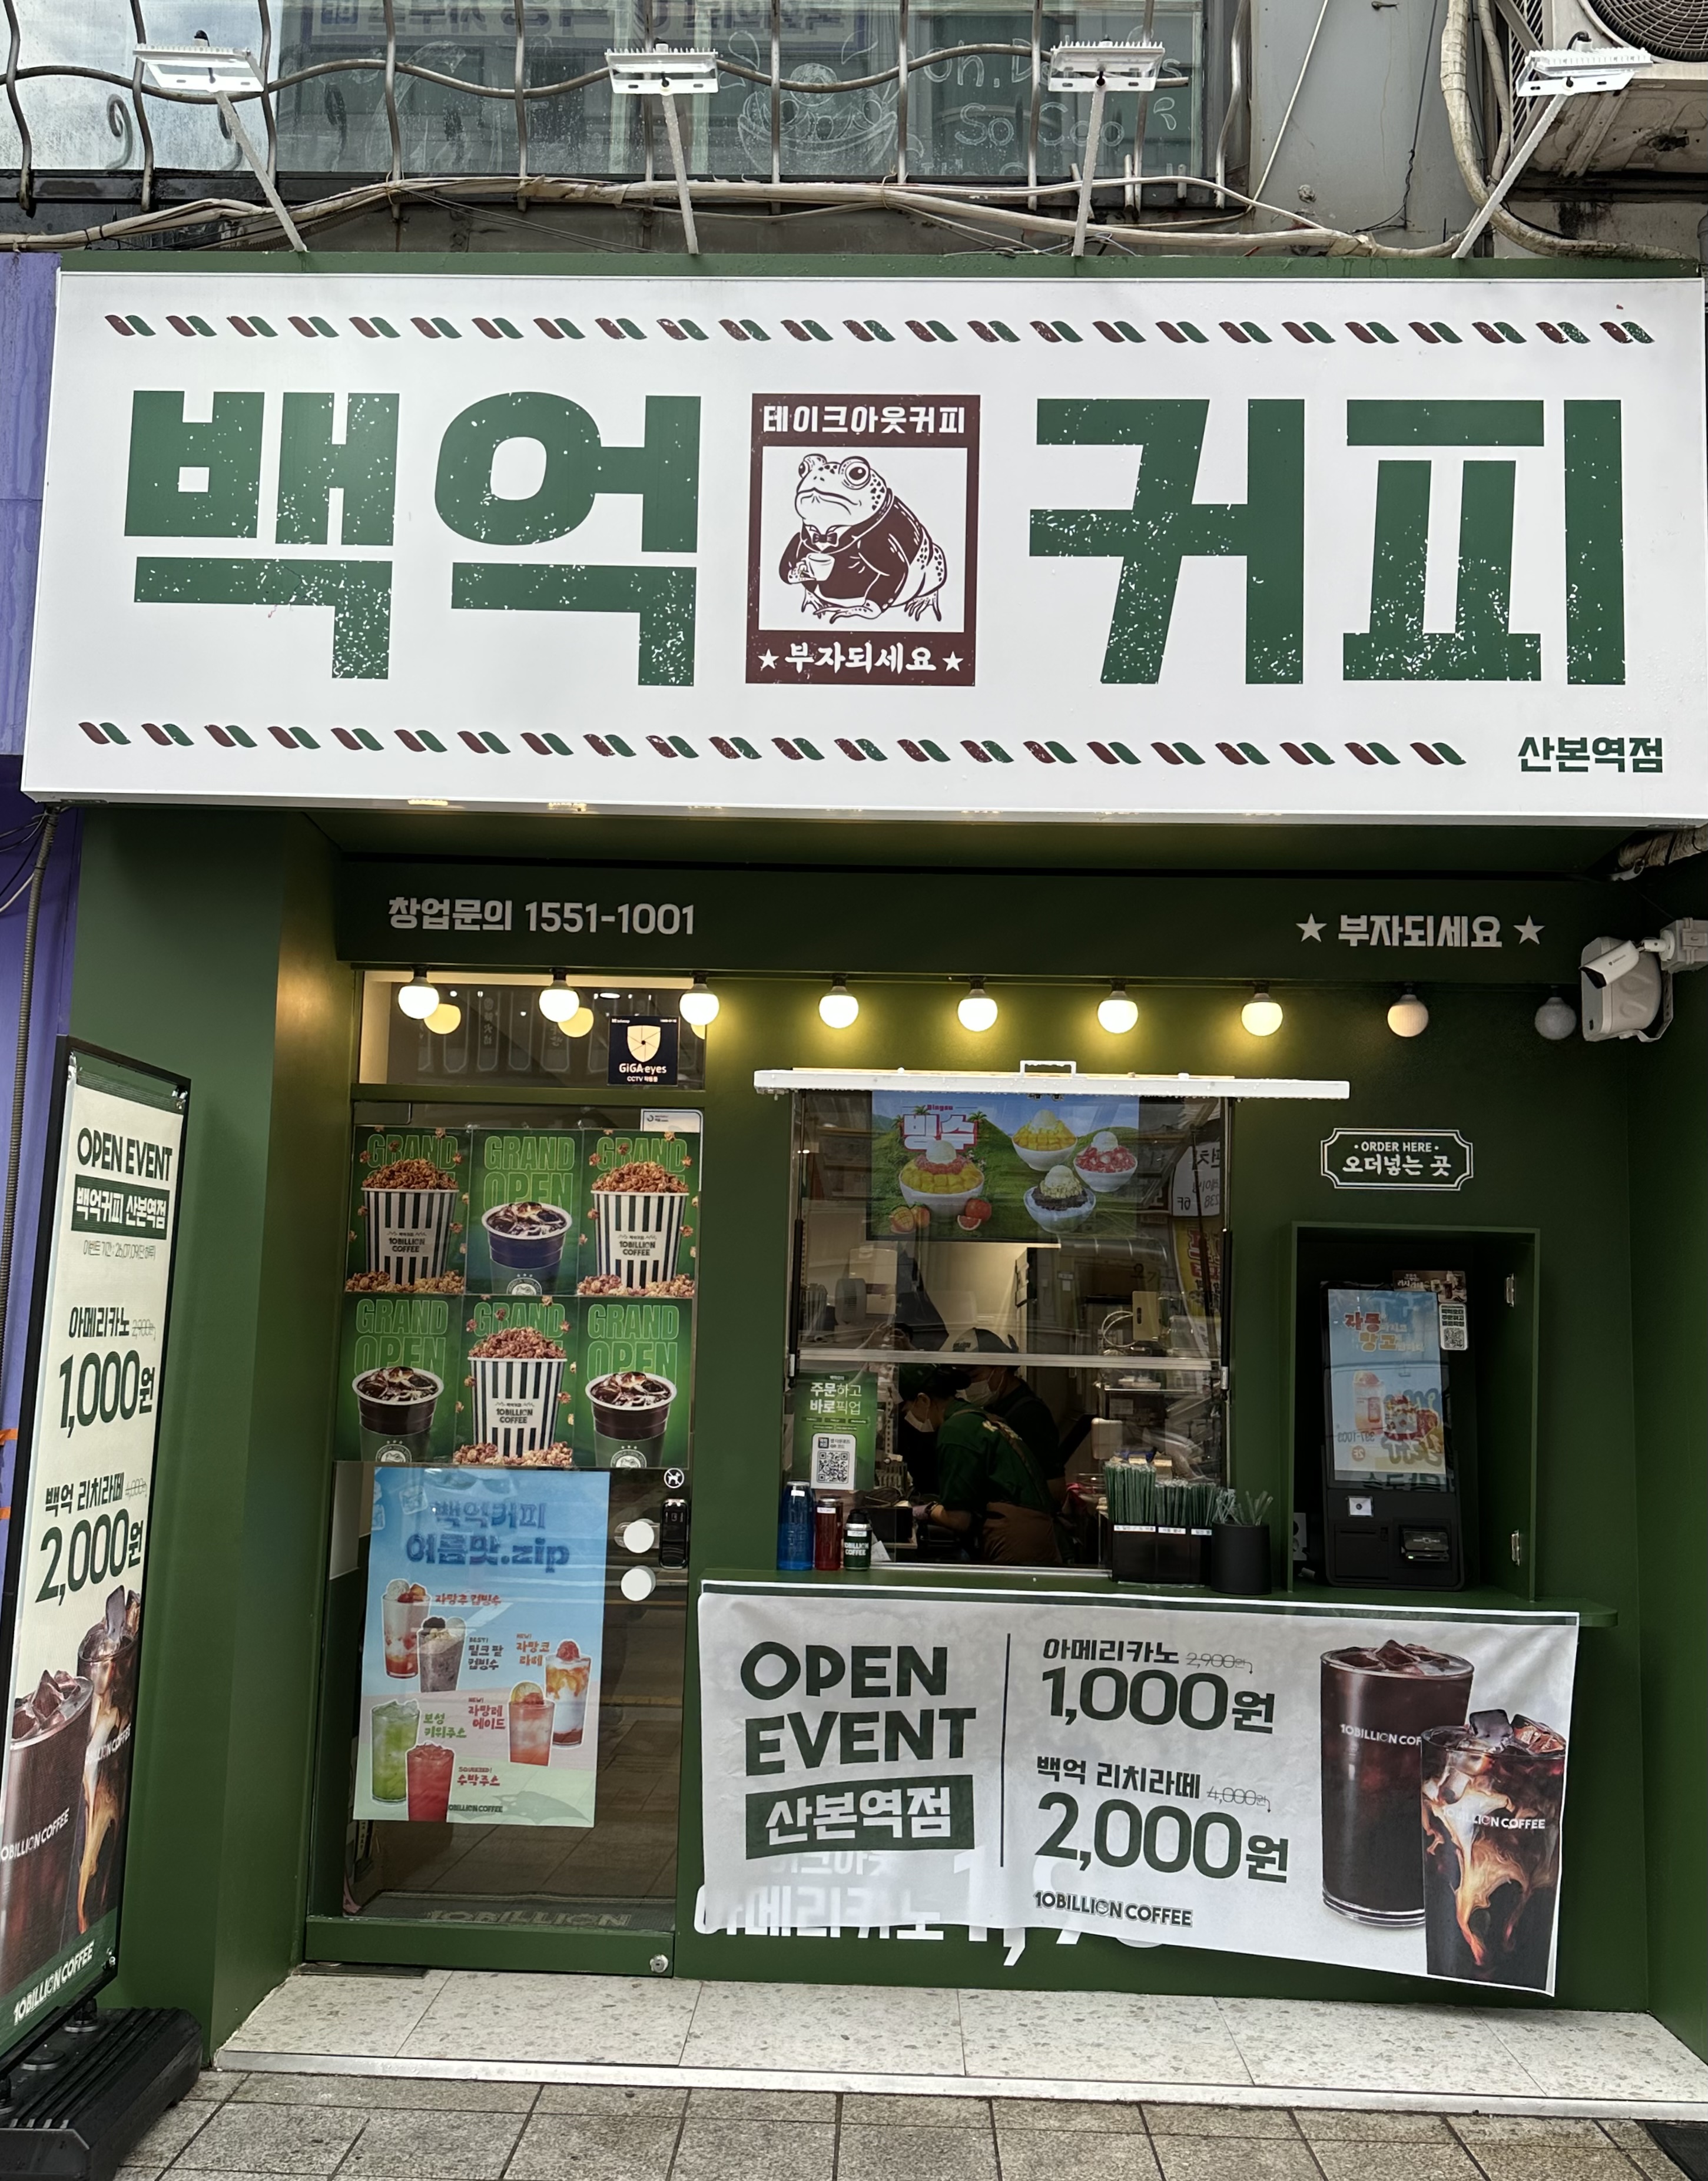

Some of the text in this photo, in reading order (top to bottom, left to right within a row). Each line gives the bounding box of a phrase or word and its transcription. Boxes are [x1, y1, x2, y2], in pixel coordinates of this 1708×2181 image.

[954, 102, 1014, 146] So
[763, 405, 965, 433] 테이크아웃커피
[124, 390, 1626, 687] 백억 커피
[785, 641, 937, 674] 부자되세요
[1517, 737, 1663, 773] 산본역점
[389, 897, 694, 934] 창업문의 1551-1001
[1338, 915, 1502, 947] 부자되세요
[903, 1114, 978, 1152] 빙수
[1361, 1141, 1432, 1152] ORDER HERE
[77, 1128, 173, 1181] OPEN EVENT
[367, 1134, 457, 1169] GRAND
[484, 1136, 575, 1171] GRAND
[596, 1137, 687, 1173] GRAND
[1342, 1154, 1451, 1176] 오더넣는 곳
[77, 1186, 167, 1229] 백억커피 산본역점
[483, 1172, 573, 1215] OPEN
[69, 1307, 130, 1338] 아메리카노
[356, 1299, 449, 1334] GRAND
[473, 1302, 566, 1338] GRAND
[588, 1304, 679, 1340] GRAND
[354, 1335, 446, 1378] OPEN
[587, 1341, 678, 1385] OPEN
[59, 1350, 155, 1438] 1,000원
[810, 1382, 862, 1398] 주문하고
[810, 1399, 861, 1416] 바로픽업
[45, 1484, 73, 1517] 백억
[77, 1472, 124, 1511] 리치라떼
[433, 1501, 546, 1529] 백억커피
[35, 1509, 144, 1606] 2,000원
[519, 1654, 543, 1666] 라떼
[1043, 1638, 1179, 1664] 아메리카노
[741, 1641, 948, 1701] OPEN
[1042, 1666, 1275, 1734] 1,000원
[423, 1713, 445, 1725] 보성
[424, 1726, 467, 1738] 키위주스
[472, 1718, 506, 1729] 에이드
[1340, 1723, 1398, 1745] 10BILLION
[745, 1708, 976, 1776] EVENT
[1037, 1756, 1086, 1785] 백억
[1097, 1762, 1200, 1800] 리치라떼
[1, 1807, 70, 1861] 0BILLION COFFEE
[766, 1787, 951, 1845] 산본역점
[1501, 1818, 1546, 1829] COFFEE
[1034, 1792, 1289, 1884] 2,000원
[1033, 1891, 1193, 1928] 10BILLION COFFEE
[14, 1941, 95, 2024] 10BILLION COFFEE
